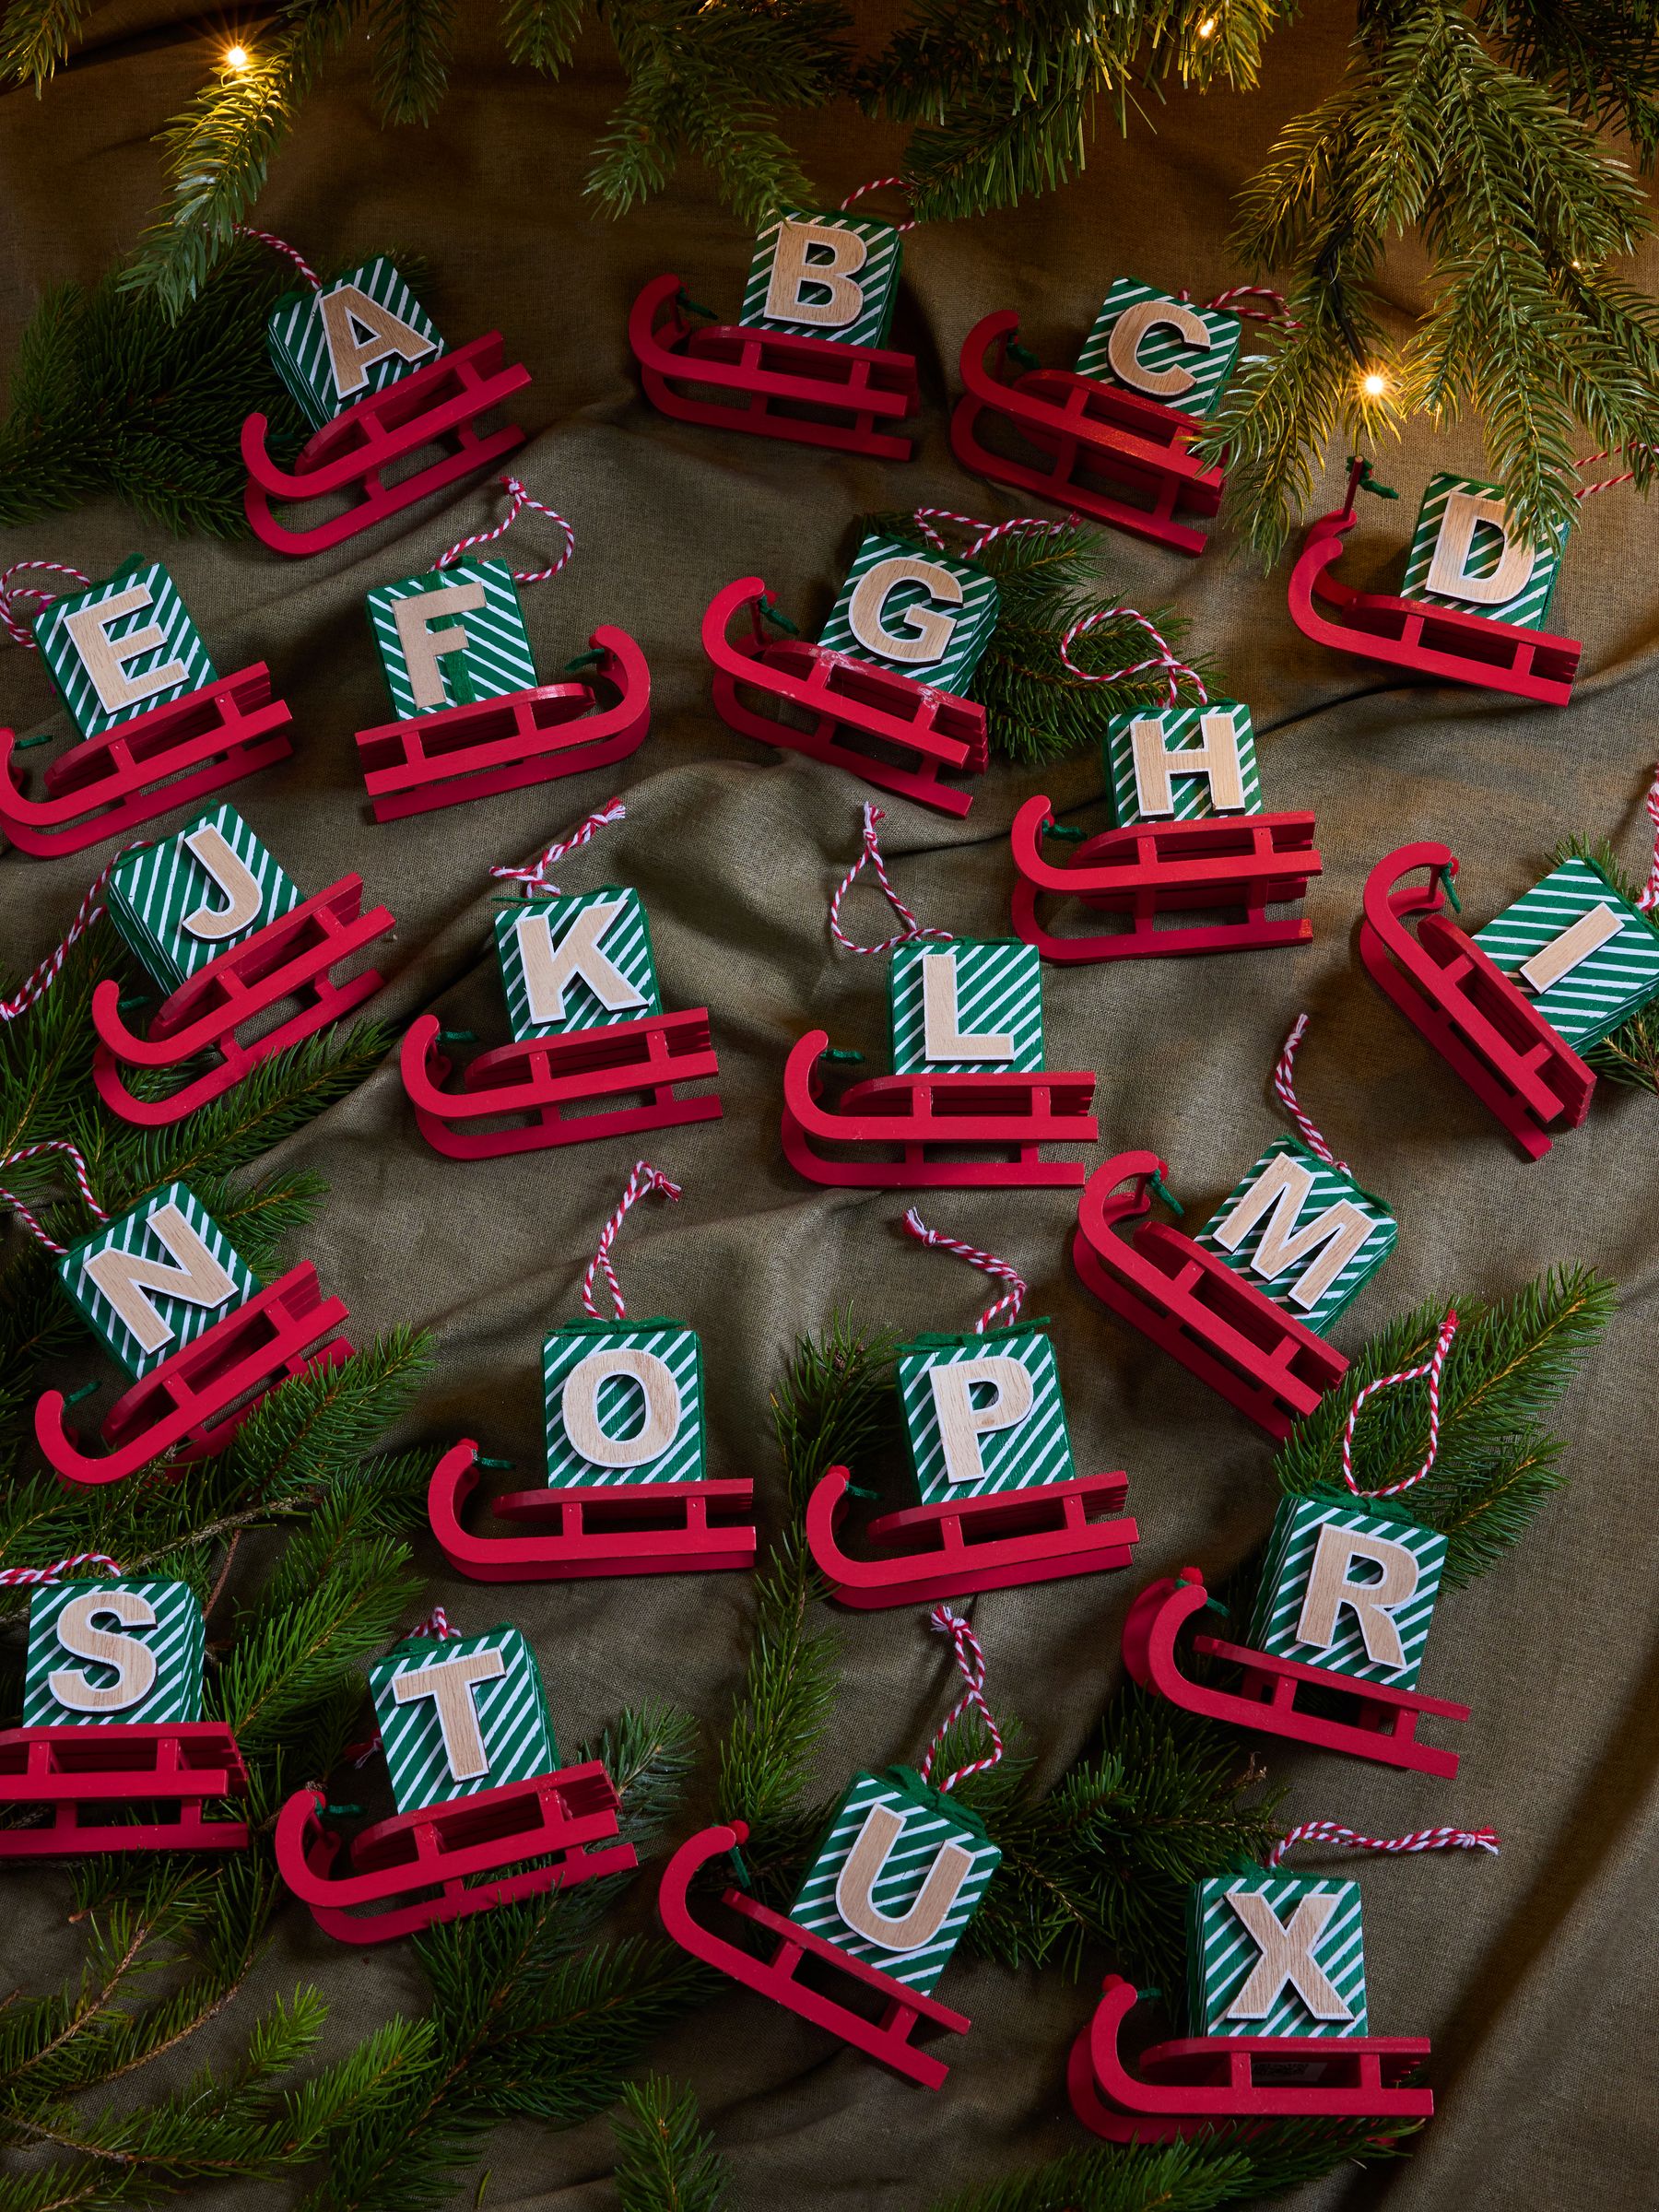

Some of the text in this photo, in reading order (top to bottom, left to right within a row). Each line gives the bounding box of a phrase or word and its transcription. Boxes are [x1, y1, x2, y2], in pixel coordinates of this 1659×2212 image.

[763, 221, 866, 327] B
[318, 283, 437, 400] A
[1108, 301, 1211, 396] C
[1425, 489, 1535, 606] D
[65, 583, 188, 716] E
[391, 581, 488, 710] F
[848, 558, 964, 663] G
[1130, 712, 1246, 818] H
[182, 823, 264, 941] J
[516, 900, 649, 1025] K
[924, 953, 1016, 1064] L
[1520, 903, 1626, 994] I
[83, 1205, 239, 1355] N
[1213, 1153, 1377, 1310] M
[561, 1348, 679, 1468] O
[930, 1355, 1034, 1483] P
[47, 1591, 158, 1713] S
[1295, 1524, 1419, 1667] R
[392, 1647, 506, 1782] T
[835, 1803, 975, 1952] U
[1224, 1892, 1355, 2022] X
